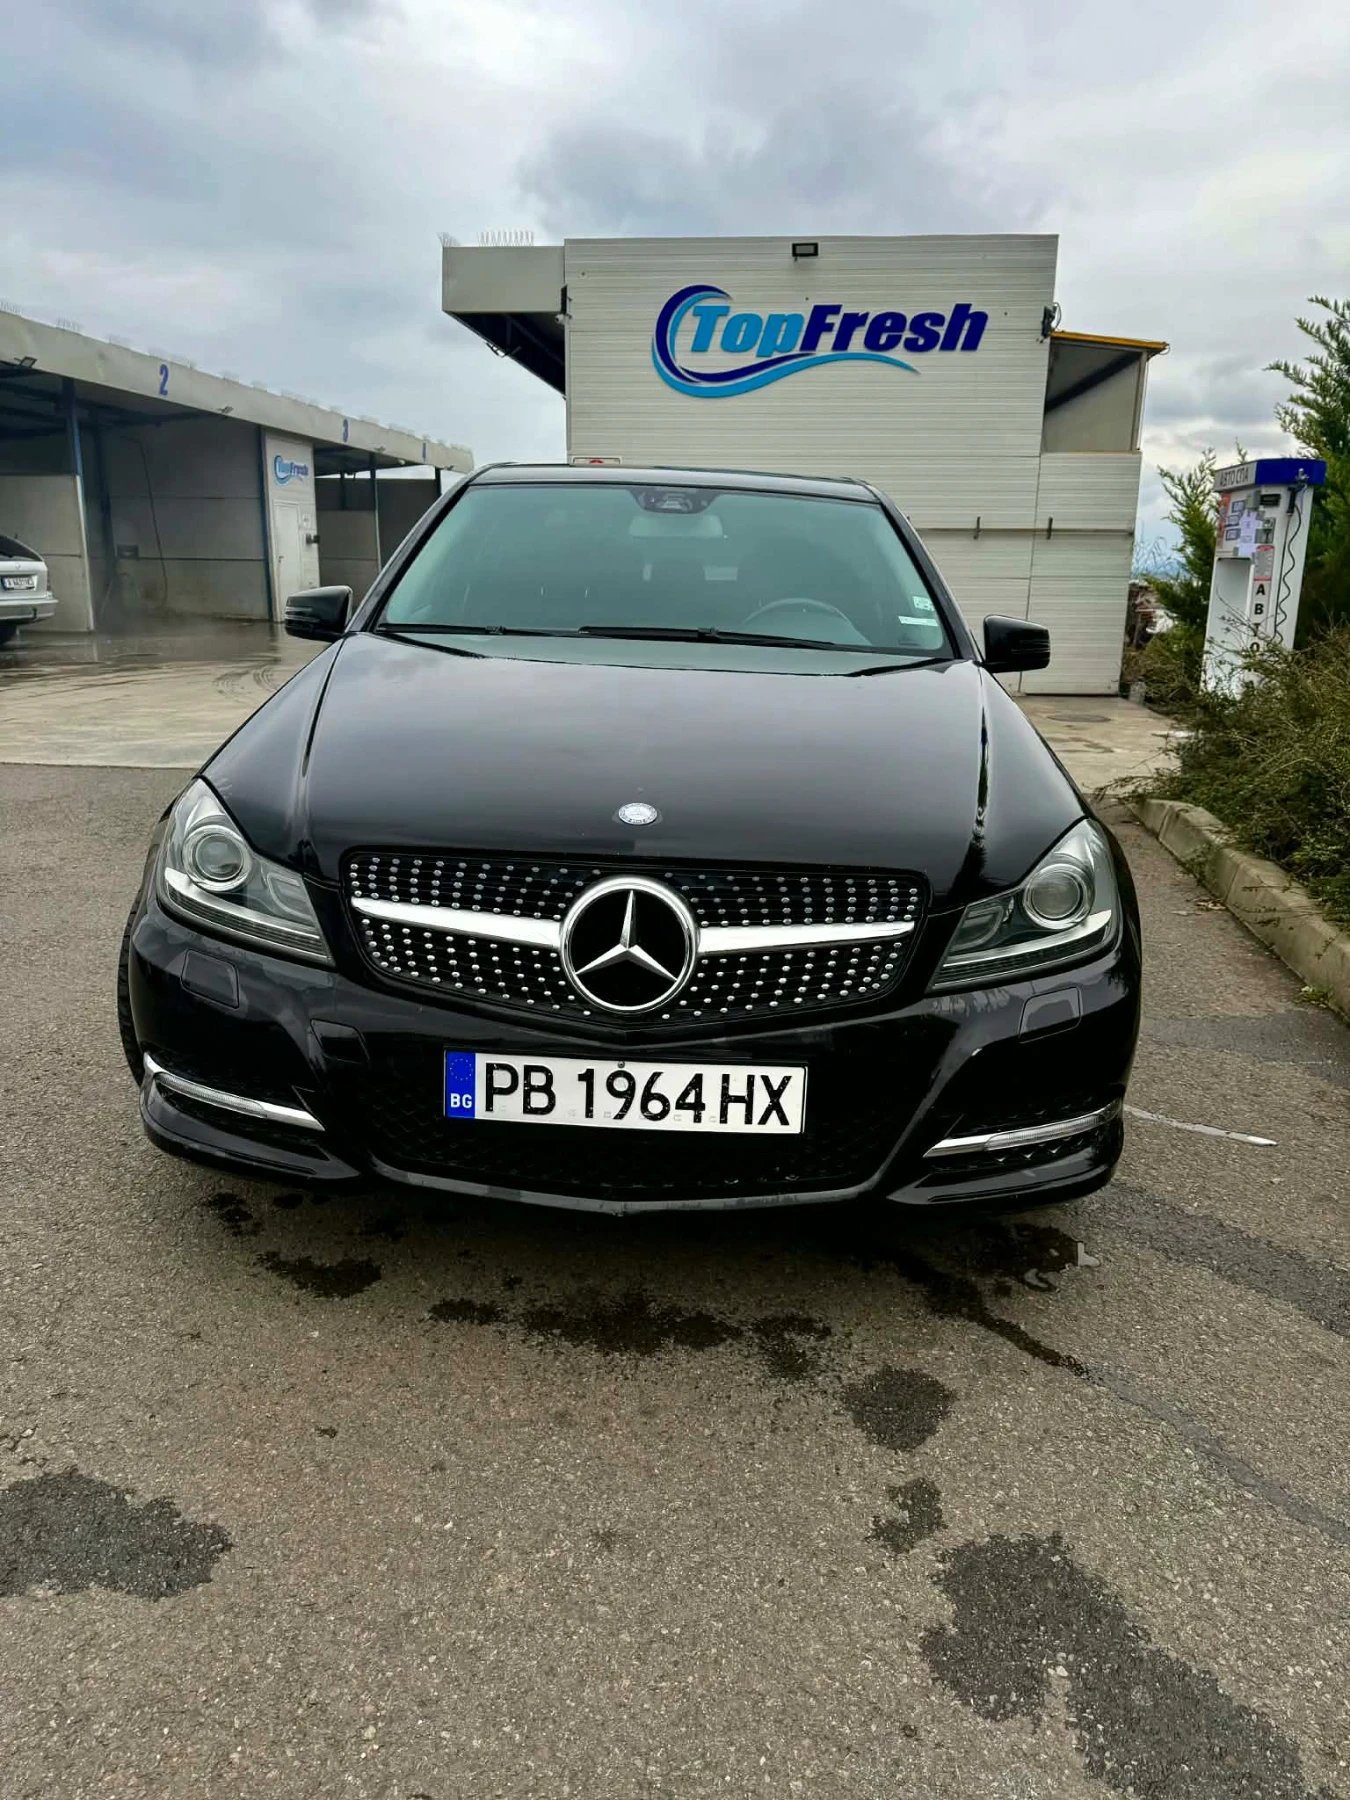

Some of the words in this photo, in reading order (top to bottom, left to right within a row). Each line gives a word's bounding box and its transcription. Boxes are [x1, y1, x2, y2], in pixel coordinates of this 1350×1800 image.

[690, 303, 989, 358] TopFresh
[159, 364, 169, 396] 2
[343, 419, 349, 443] 3
[450, 1093, 472, 1109] BG
[485, 1062, 556, 1116] PB
[578, 1068, 706, 1124] 1964
[719, 1073, 792, 1126] HX
